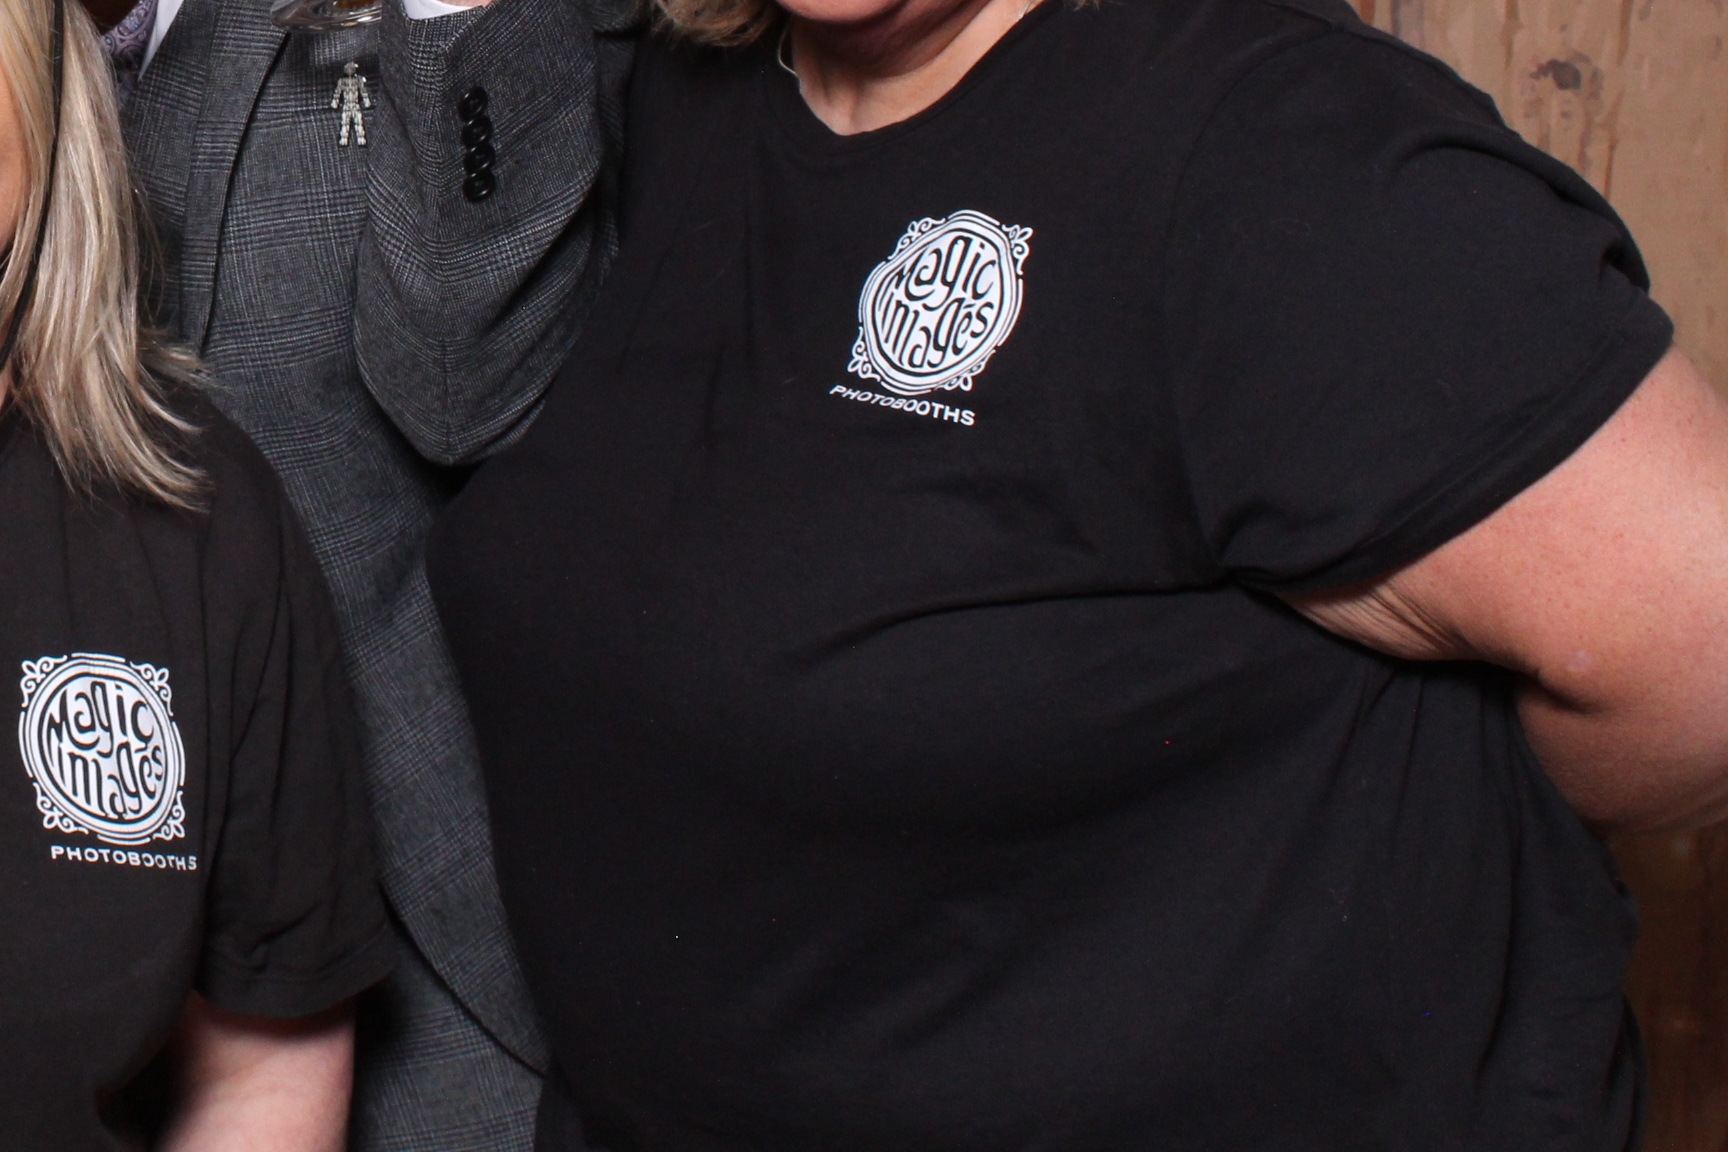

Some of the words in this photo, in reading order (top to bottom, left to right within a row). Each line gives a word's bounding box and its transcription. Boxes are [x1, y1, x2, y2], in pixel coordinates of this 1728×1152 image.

[878, 235, 997, 312] Magic
[829, 384, 976, 426] PHOTOBOOTHS
[46, 680, 154, 767] Magic
[50, 844, 198, 871] PHOTOBOOTHS
